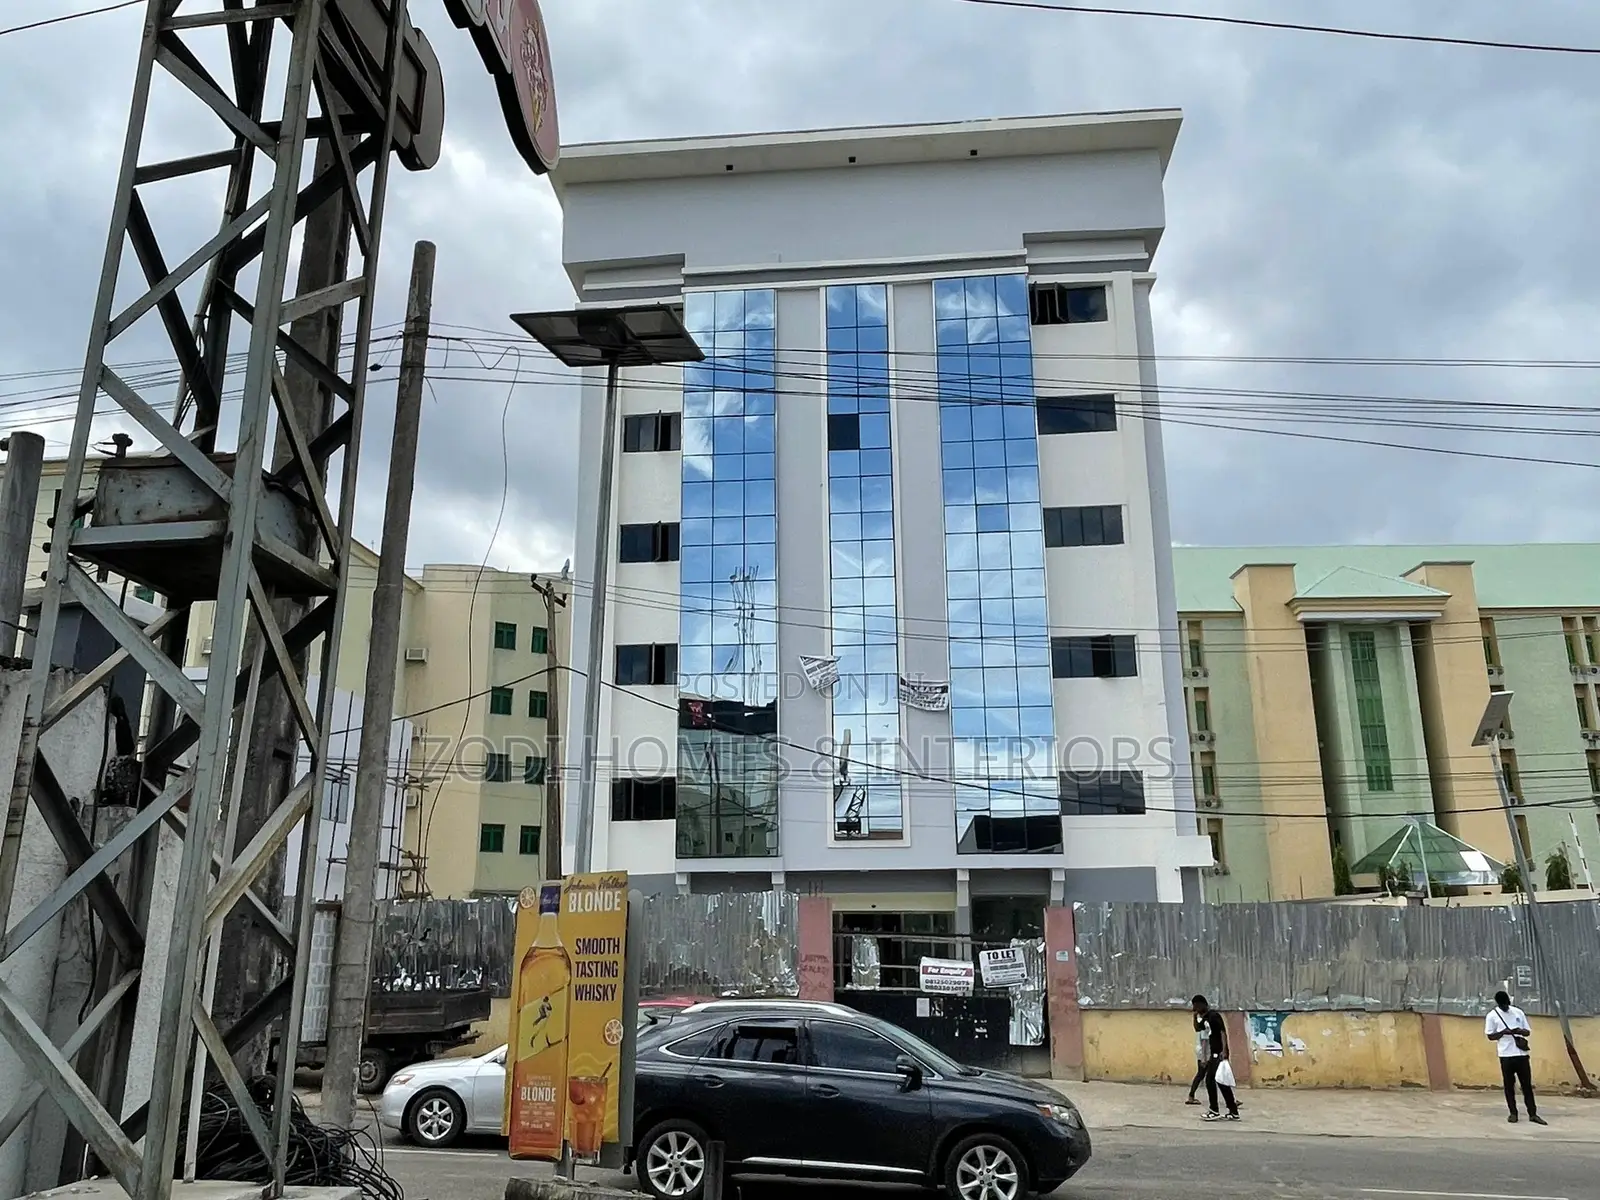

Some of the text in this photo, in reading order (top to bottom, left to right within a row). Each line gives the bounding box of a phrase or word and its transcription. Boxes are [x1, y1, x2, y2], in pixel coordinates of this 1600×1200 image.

[568, 890, 622, 912] BLONDE
[575, 937, 620, 955] SMOOTH
[986, 949, 1016, 960] TO LET
[575, 960, 618, 978] TASTING
[940, 967, 967, 976] Enquiry
[575, 984, 617, 1001] WHISKY
[520, 1086, 557, 1102] BLONDE
